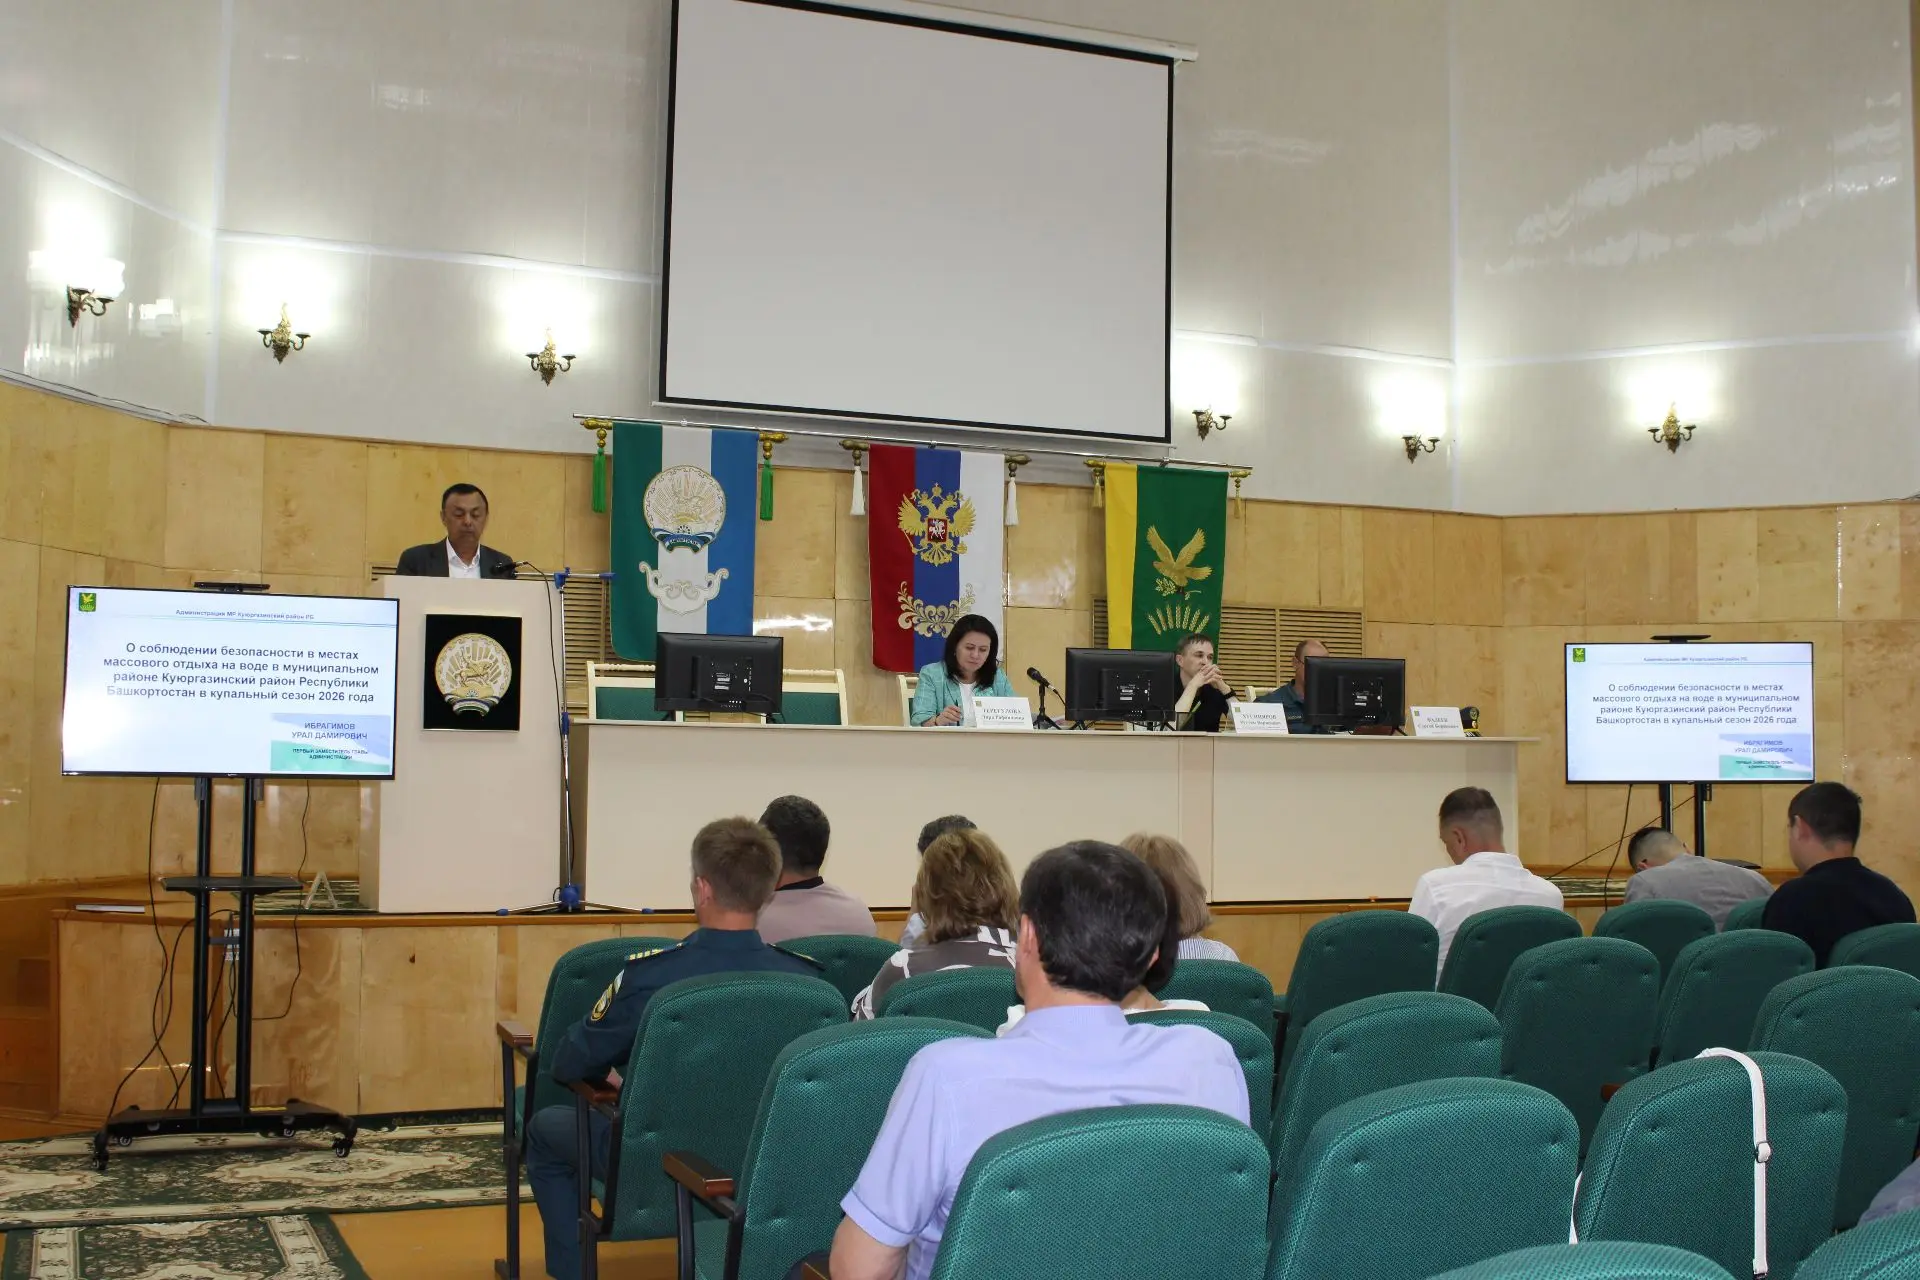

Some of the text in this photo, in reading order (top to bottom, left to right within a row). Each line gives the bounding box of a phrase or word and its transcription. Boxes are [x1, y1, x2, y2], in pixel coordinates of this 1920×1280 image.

[126, 642, 359, 660] О соблюдении безопасности в местах
[103, 658, 379, 675] массового отдыха на воде в муниципальном
[113, 671, 369, 690] районе Куюргазинский район Республики
[1608, 683, 1616, 692] О
[1618, 683, 1676, 693] соблюдении
[1678, 683, 1741, 692] безопасности
[106, 685, 375, 703] Башкортостан в купальный сезон 2026 года
[1692, 695, 1714, 703] воде
[1725, 695, 1800, 704] муниципальном
[1600, 705, 1793, 715] районе Куюргазинский район Республики
[1596, 716, 1661, 725] Башкортостан
[1671, 716, 1723, 725] купальный
[1753, 716, 1774, 724] 2026
[1776, 717, 1797, 725] года
[304, 722, 356, 730] ИБРАГИМОВ
[292, 731, 368, 740] УРАЛ ДАМИРОВИЧ
